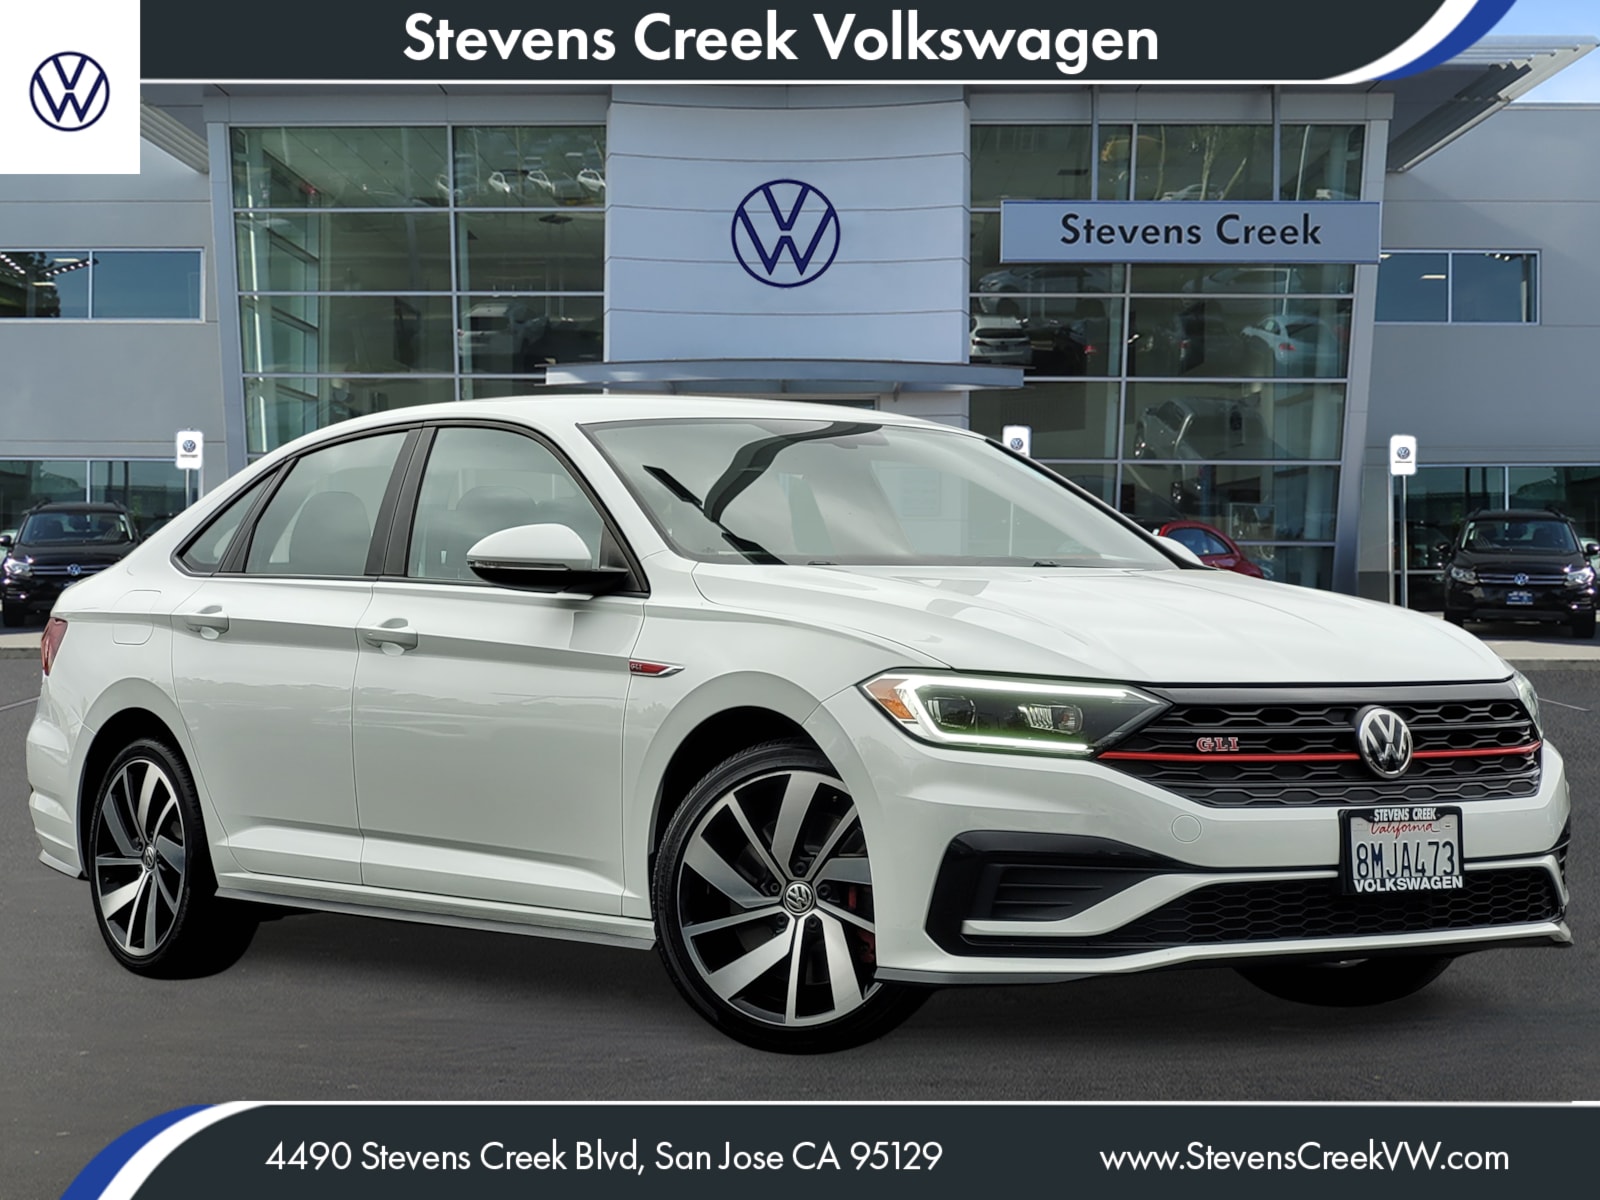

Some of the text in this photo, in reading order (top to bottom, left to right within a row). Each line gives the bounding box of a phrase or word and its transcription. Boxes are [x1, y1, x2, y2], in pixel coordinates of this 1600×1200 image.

[731, 179, 841, 288] VW
[1060, 212, 1321, 245] Stevens Creek
[1196, 736, 1239, 752] GLI
[1374, 807, 1437, 822] STEVENS CREEK
[1371, 821, 1440, 839] California
[1356, 841, 1454, 878] 8MJA473
[1354, 876, 1463, 892] VOLKSWAGEN
